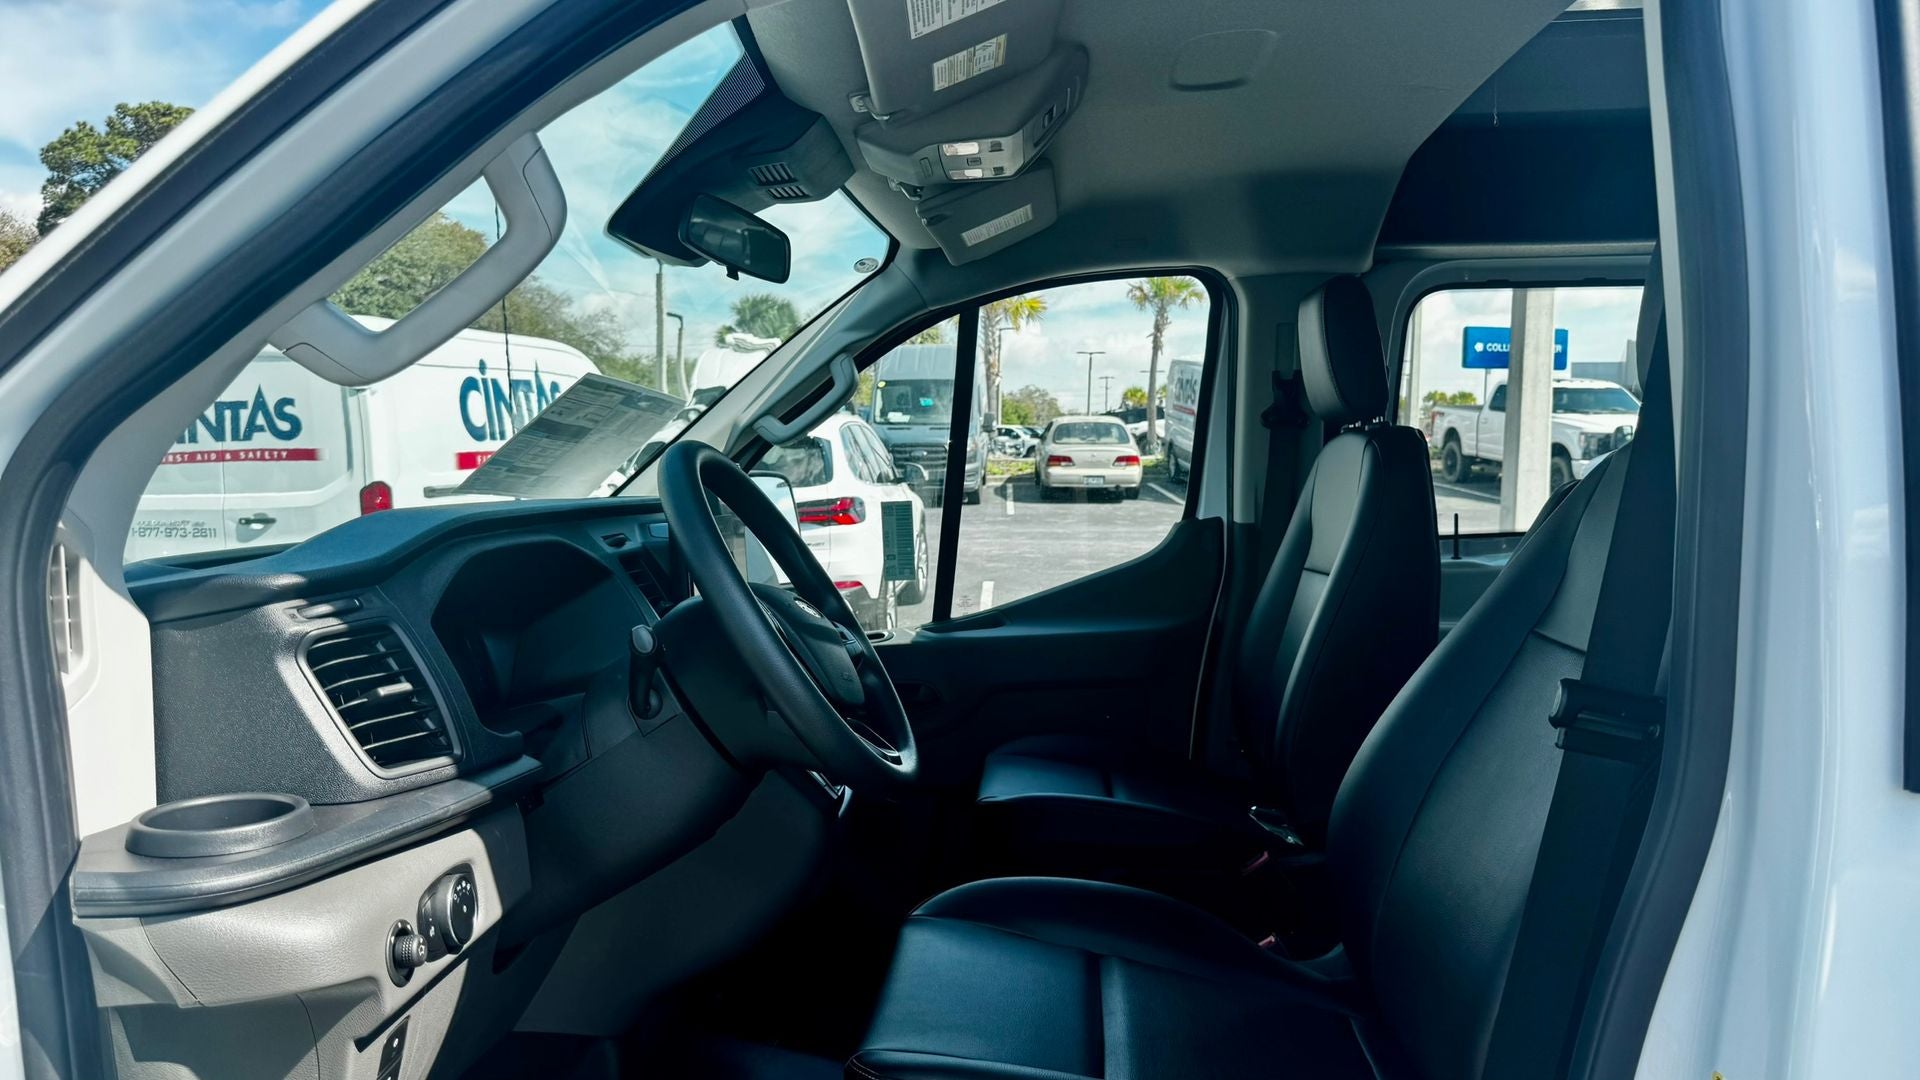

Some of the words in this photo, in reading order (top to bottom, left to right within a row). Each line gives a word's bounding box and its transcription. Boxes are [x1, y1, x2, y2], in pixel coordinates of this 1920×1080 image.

[1486, 342, 1510, 352] COLLI
[176, 384, 303, 444] NTAS
[163, 454, 189, 463] IRST
[196, 452, 217, 461] AID
[224, 452, 231, 460] &
[239, 450, 288, 460] SAFETY
